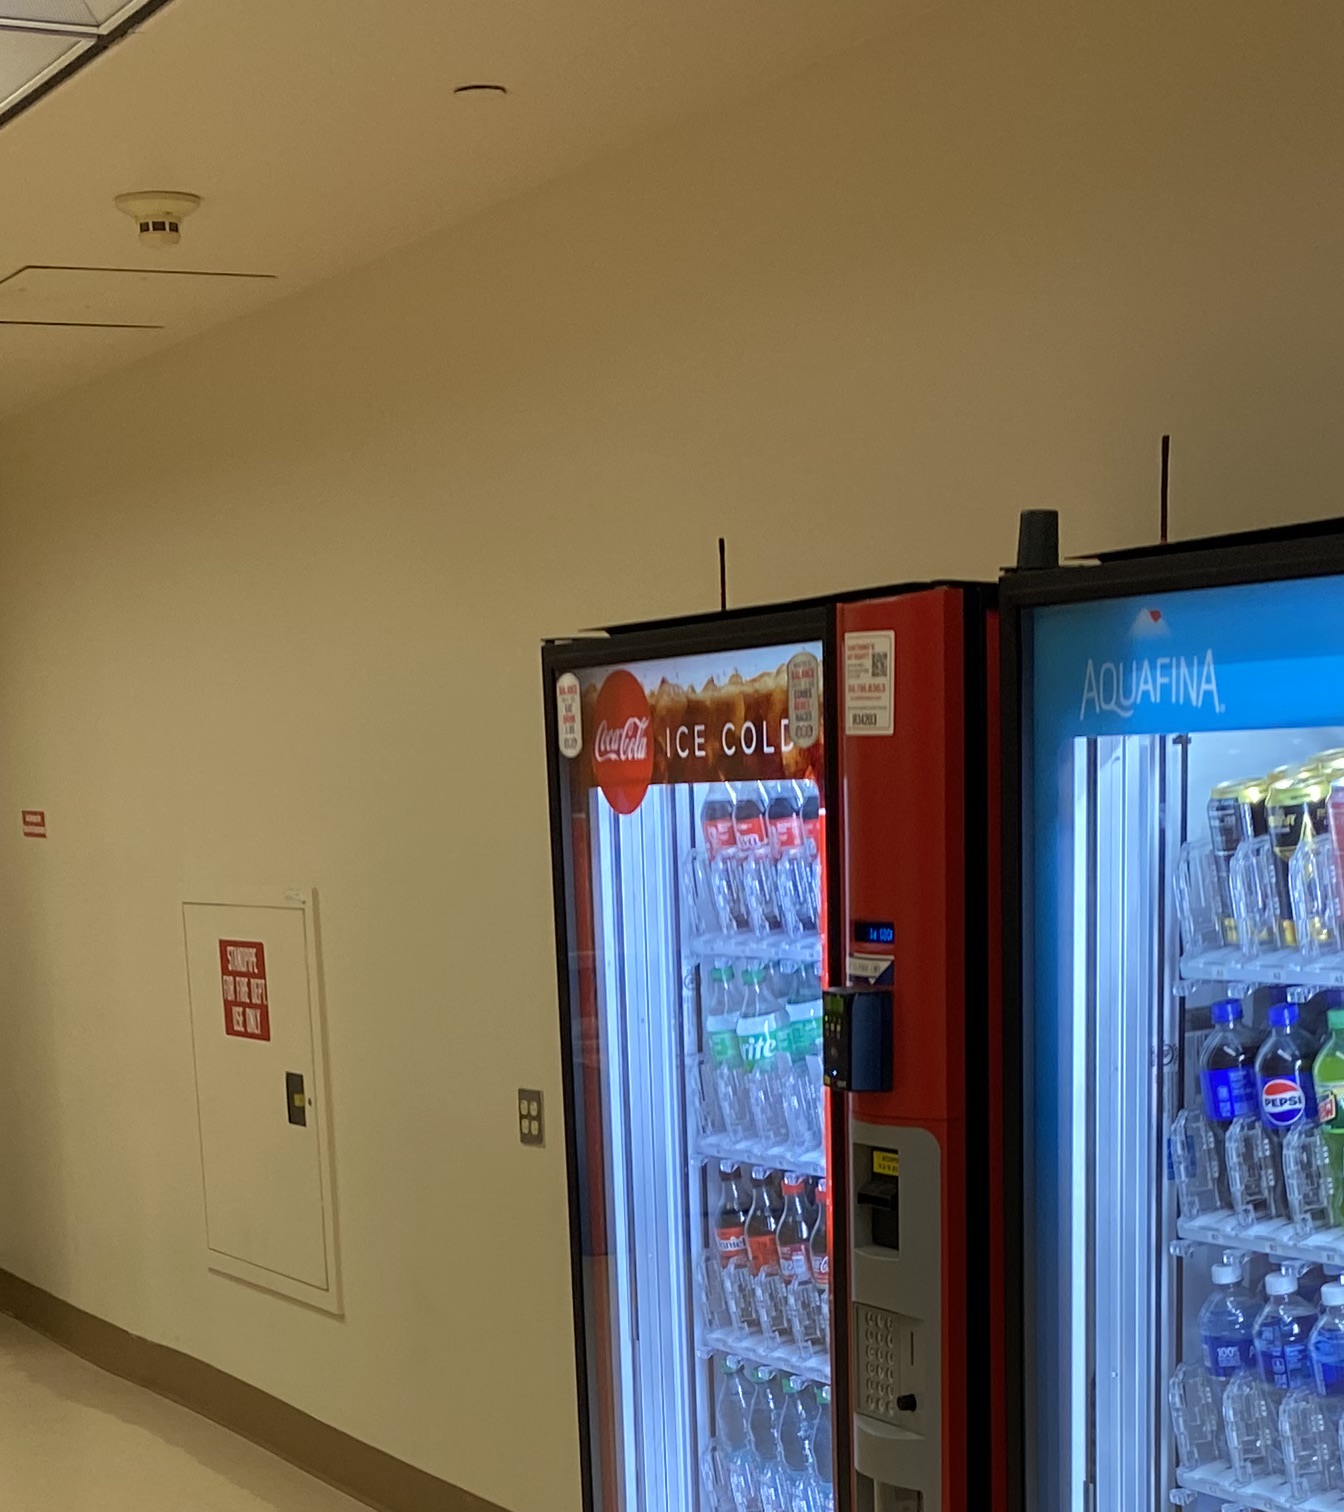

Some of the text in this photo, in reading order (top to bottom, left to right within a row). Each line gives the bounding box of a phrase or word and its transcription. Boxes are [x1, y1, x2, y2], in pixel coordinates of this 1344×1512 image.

[1080, 648, 1220, 721] AQUAFINA
[595, 717, 649, 762] Coca-Cola
[666, 718, 795, 758] ICE COLD
[1264, 1094, 1304, 1108] PEPSI
